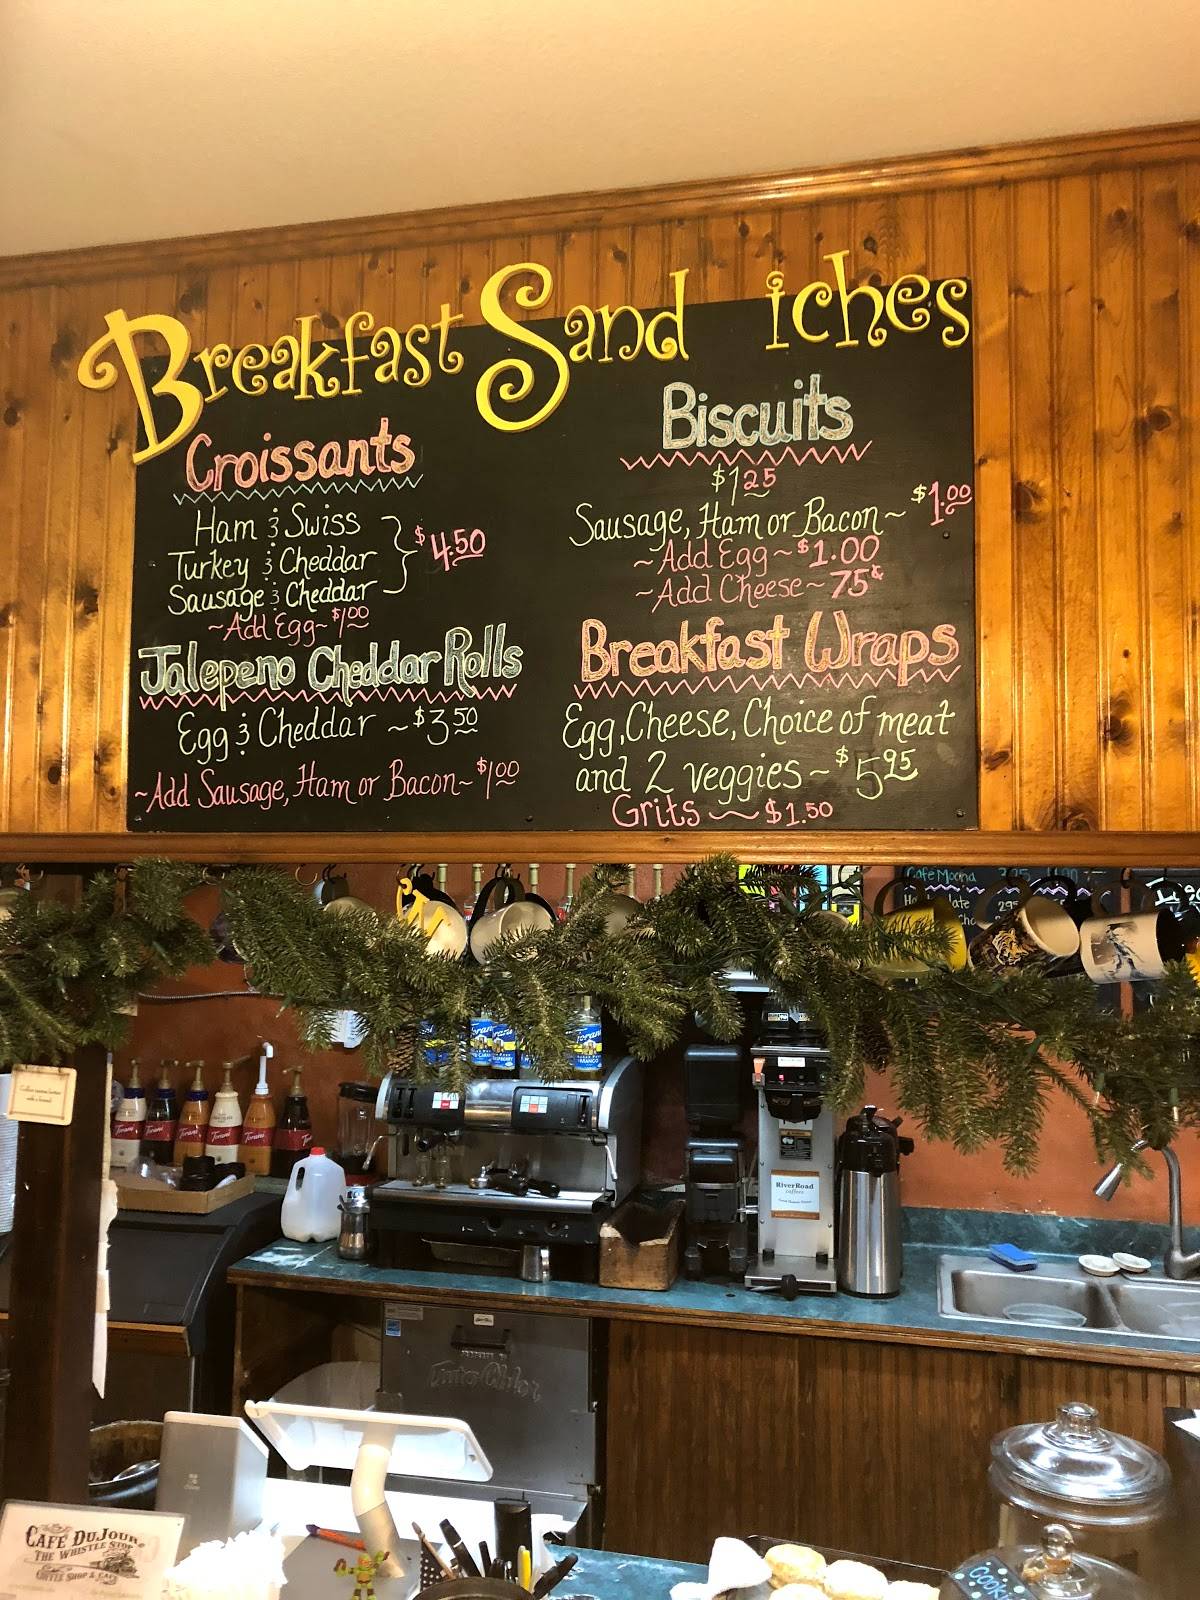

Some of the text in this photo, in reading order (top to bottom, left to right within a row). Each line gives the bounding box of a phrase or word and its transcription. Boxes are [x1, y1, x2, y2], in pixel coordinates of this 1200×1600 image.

[78, 304, 464, 465] Breakfast
[766, 250, 970, 349] iches
[663, 373, 854, 450] Biscuits
[185, 417, 416, 493] Croissants
[195, 509, 257, 547] Ham
[285, 502, 361, 538] Swiss
[569, 502, 691, 552] Sausage,
[698, 501, 761, 541] Ham
[767, 512, 790, 534] or
[167, 551, 250, 590] Turkey
[279, 545, 377, 574] Cheddar
[719, 539, 768, 578] Egg
[167, 585, 265, 622] Sausage
[285, 577, 377, 613] Cheddar
[719, 573, 802, 609] Cheese
[138, 623, 523, 711] Jalepeno Cheddar Rolls
[580, 610, 961, 687] Breakfast Wraps
[177, 711, 229, 764] Egg
[258, 706, 376, 748] Cheddar
[743, 696, 833, 744] Choice
[839, 695, 877, 735] of
[877, 700, 956, 745] meat
[292, 760, 357, 804] Ham
[358, 775, 381, 796] or
[576, 754, 632, 794] and
[645, 750, 673, 796] 2
[683, 752, 802, 806] veggies
[612, 794, 701, 829] Grits
